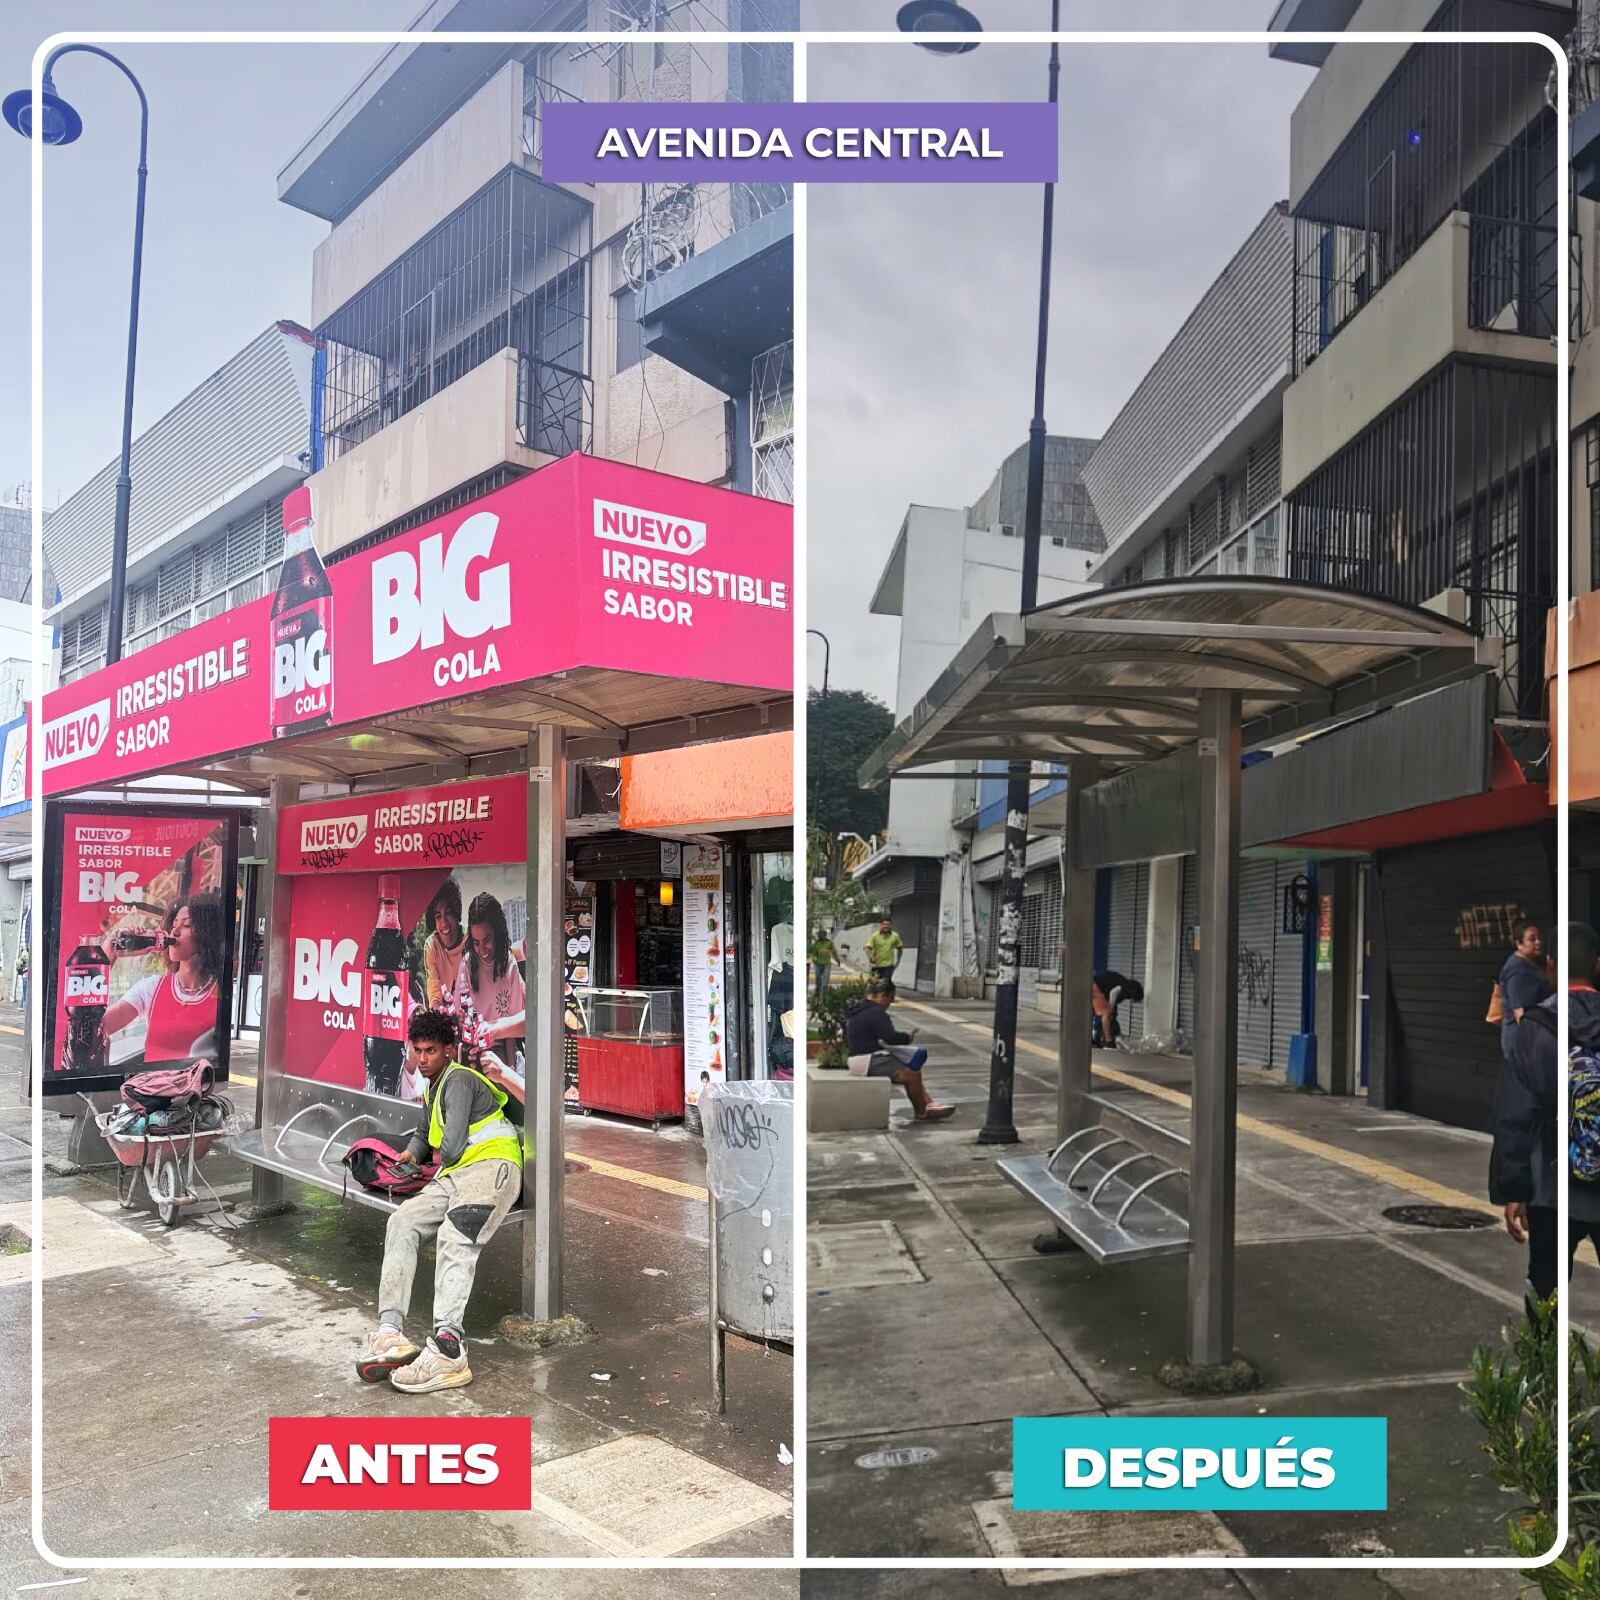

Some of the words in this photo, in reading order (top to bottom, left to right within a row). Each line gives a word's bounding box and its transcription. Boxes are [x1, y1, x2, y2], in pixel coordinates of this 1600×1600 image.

[602, 508, 692, 549] NUEVO
[372, 511, 511, 665] BIG
[602, 549, 788, 610] IRRESISTIBLE
[604, 589, 693, 626] SABOR
[277, 623, 298, 638] NUEVA
[116, 638, 249, 721] IRRESISTIBLE
[275, 629, 331, 699] BIG
[433, 643, 501, 687] COLA
[295, 691, 326, 714] COLA
[45, 713, 99, 762] NUEVO
[116, 716, 170, 757] SABOR
[374, 796, 491, 829] IRRESISTIBLE
[80, 829, 123, 840] NUEVO
[305, 821, 358, 847] NUEVO
[374, 832, 423, 855] SABOR
[79, 844, 171, 857] IRRESISTIBLE
[79, 858, 122, 868] SABOR
[79, 871, 143, 903] BIG
[109, 905, 138, 914] COLA
[67, 975, 107, 996] BIG
[293, 937, 361, 1008] BIG
[370, 983, 402, 1018] BIG
[323, 1009, 355, 1031] COLA
[382, 1018, 400, 1030] COLA
